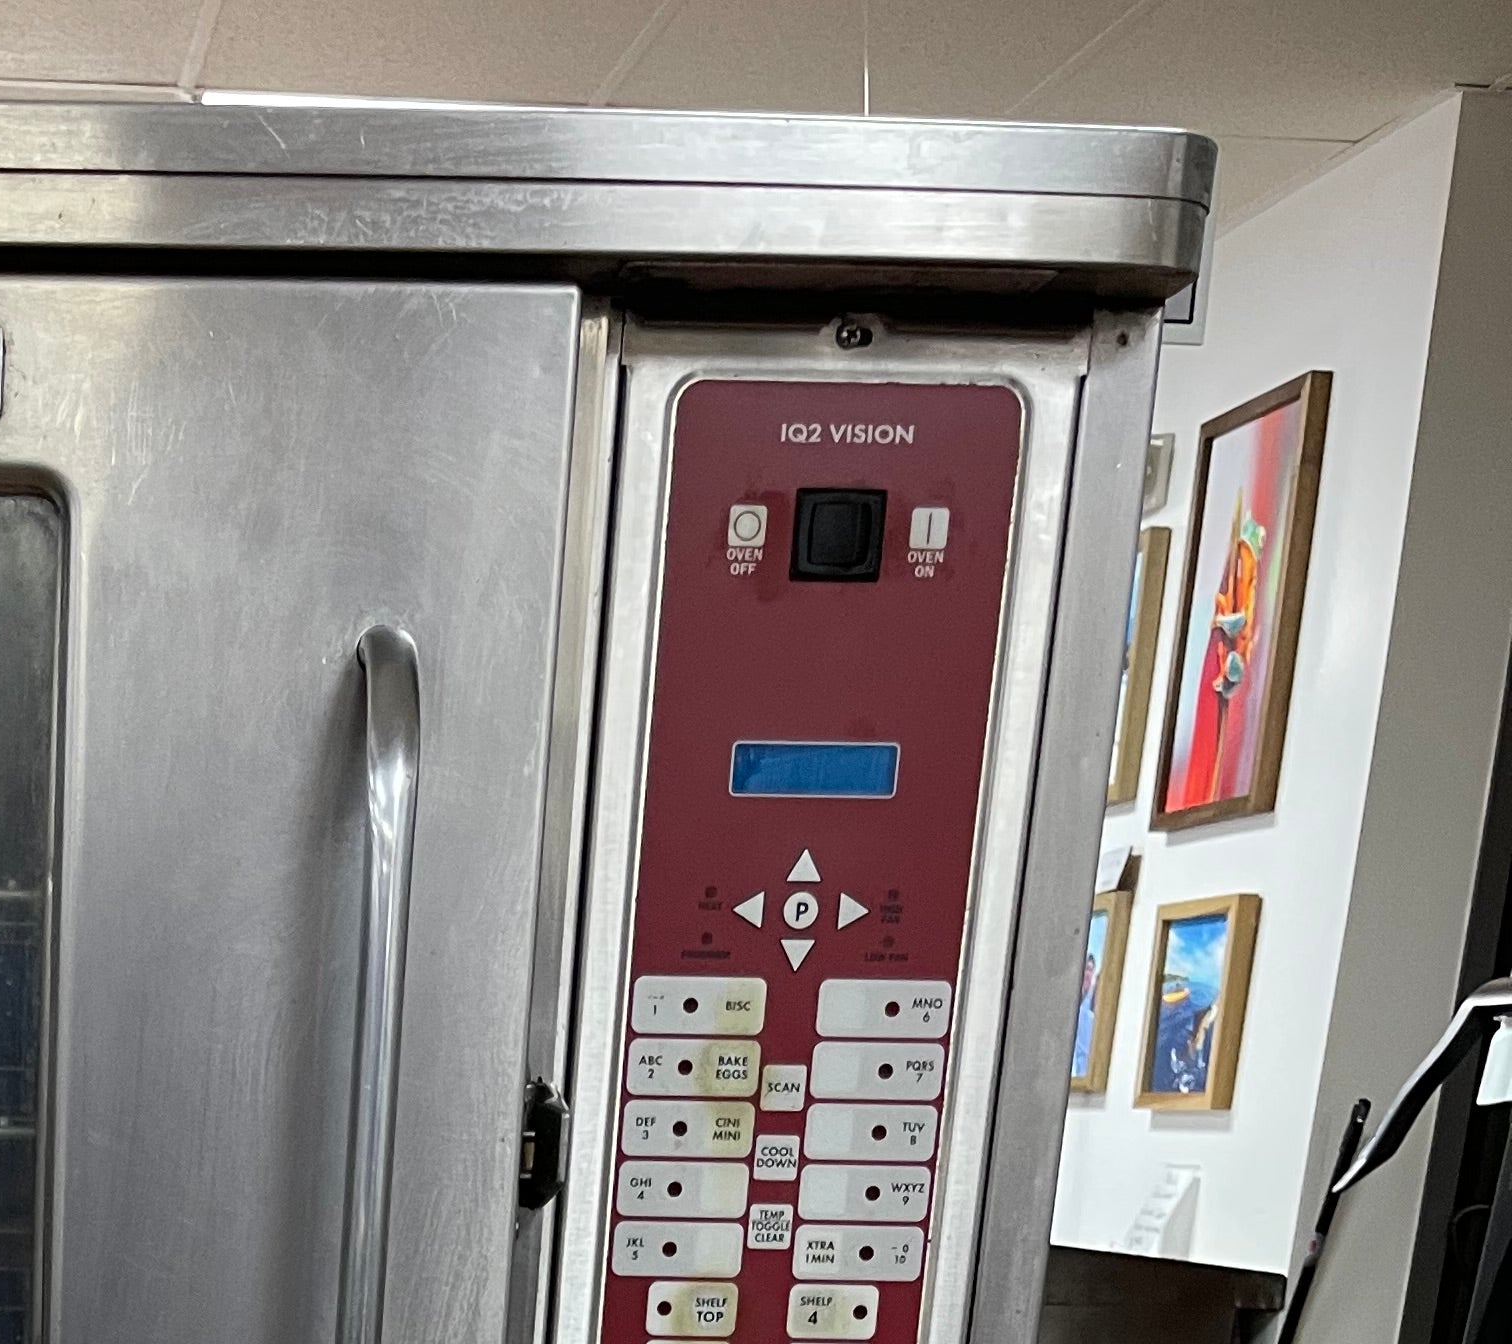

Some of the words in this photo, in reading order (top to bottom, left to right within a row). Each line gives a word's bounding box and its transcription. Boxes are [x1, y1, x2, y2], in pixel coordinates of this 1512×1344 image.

[780, 423, 822, 443] IQ2
[829, 424, 916, 445] VISION
[726, 548, 764, 562] OVEN
[907, 551, 945, 564] OVEN
[730, 562, 757, 576] OFF
[914, 565, 935, 578] ON
[794, 901, 809, 922] P
[725, 1000, 752, 1012] BISC
[911, 997, 944, 1010] MNO
[921, 1011, 931, 1023] 6
[638, 1055, 664, 1066] ABC
[717, 1055, 749, 1067] BAKE
[905, 1060, 935, 1072] PQRS
[648, 1068, 656, 1079] 2
[715, 1068, 748, 1080] EGGS
[916, 1073, 923, 1083] 7
[766, 1082, 801, 1094] SCAN
[635, 1116, 657, 1128] DEF
[902, 1121, 926, 1133] TUV
[641, 1129, 650, 1140] 3
[712, 1130, 741, 1141] MINI
[760, 1146, 795, 1158] COOL
[756, 1157, 797, 1169] DOWN
[629, 1177, 652, 1188] GHI
[891, 1182, 925, 1194] WXYZ
[636, 1190, 645, 1200] 4
[902, 1195, 910, 1206] 9
[758, 1209, 786, 1221] TEMP
[751, 1220, 791, 1233] TOGGLE
[626, 1238, 645, 1248] JKL
[754, 1232, 785, 1244] CLEAR
[805, 1240, 836, 1251] XTRA
[631, 1251, 639, 1261] 5
[694, 1297, 729, 1308] SHELF
[799, 1295, 834, 1307] SHELF
[696, 1310, 724, 1323] TOP
[807, 1310, 818, 1325] 4
